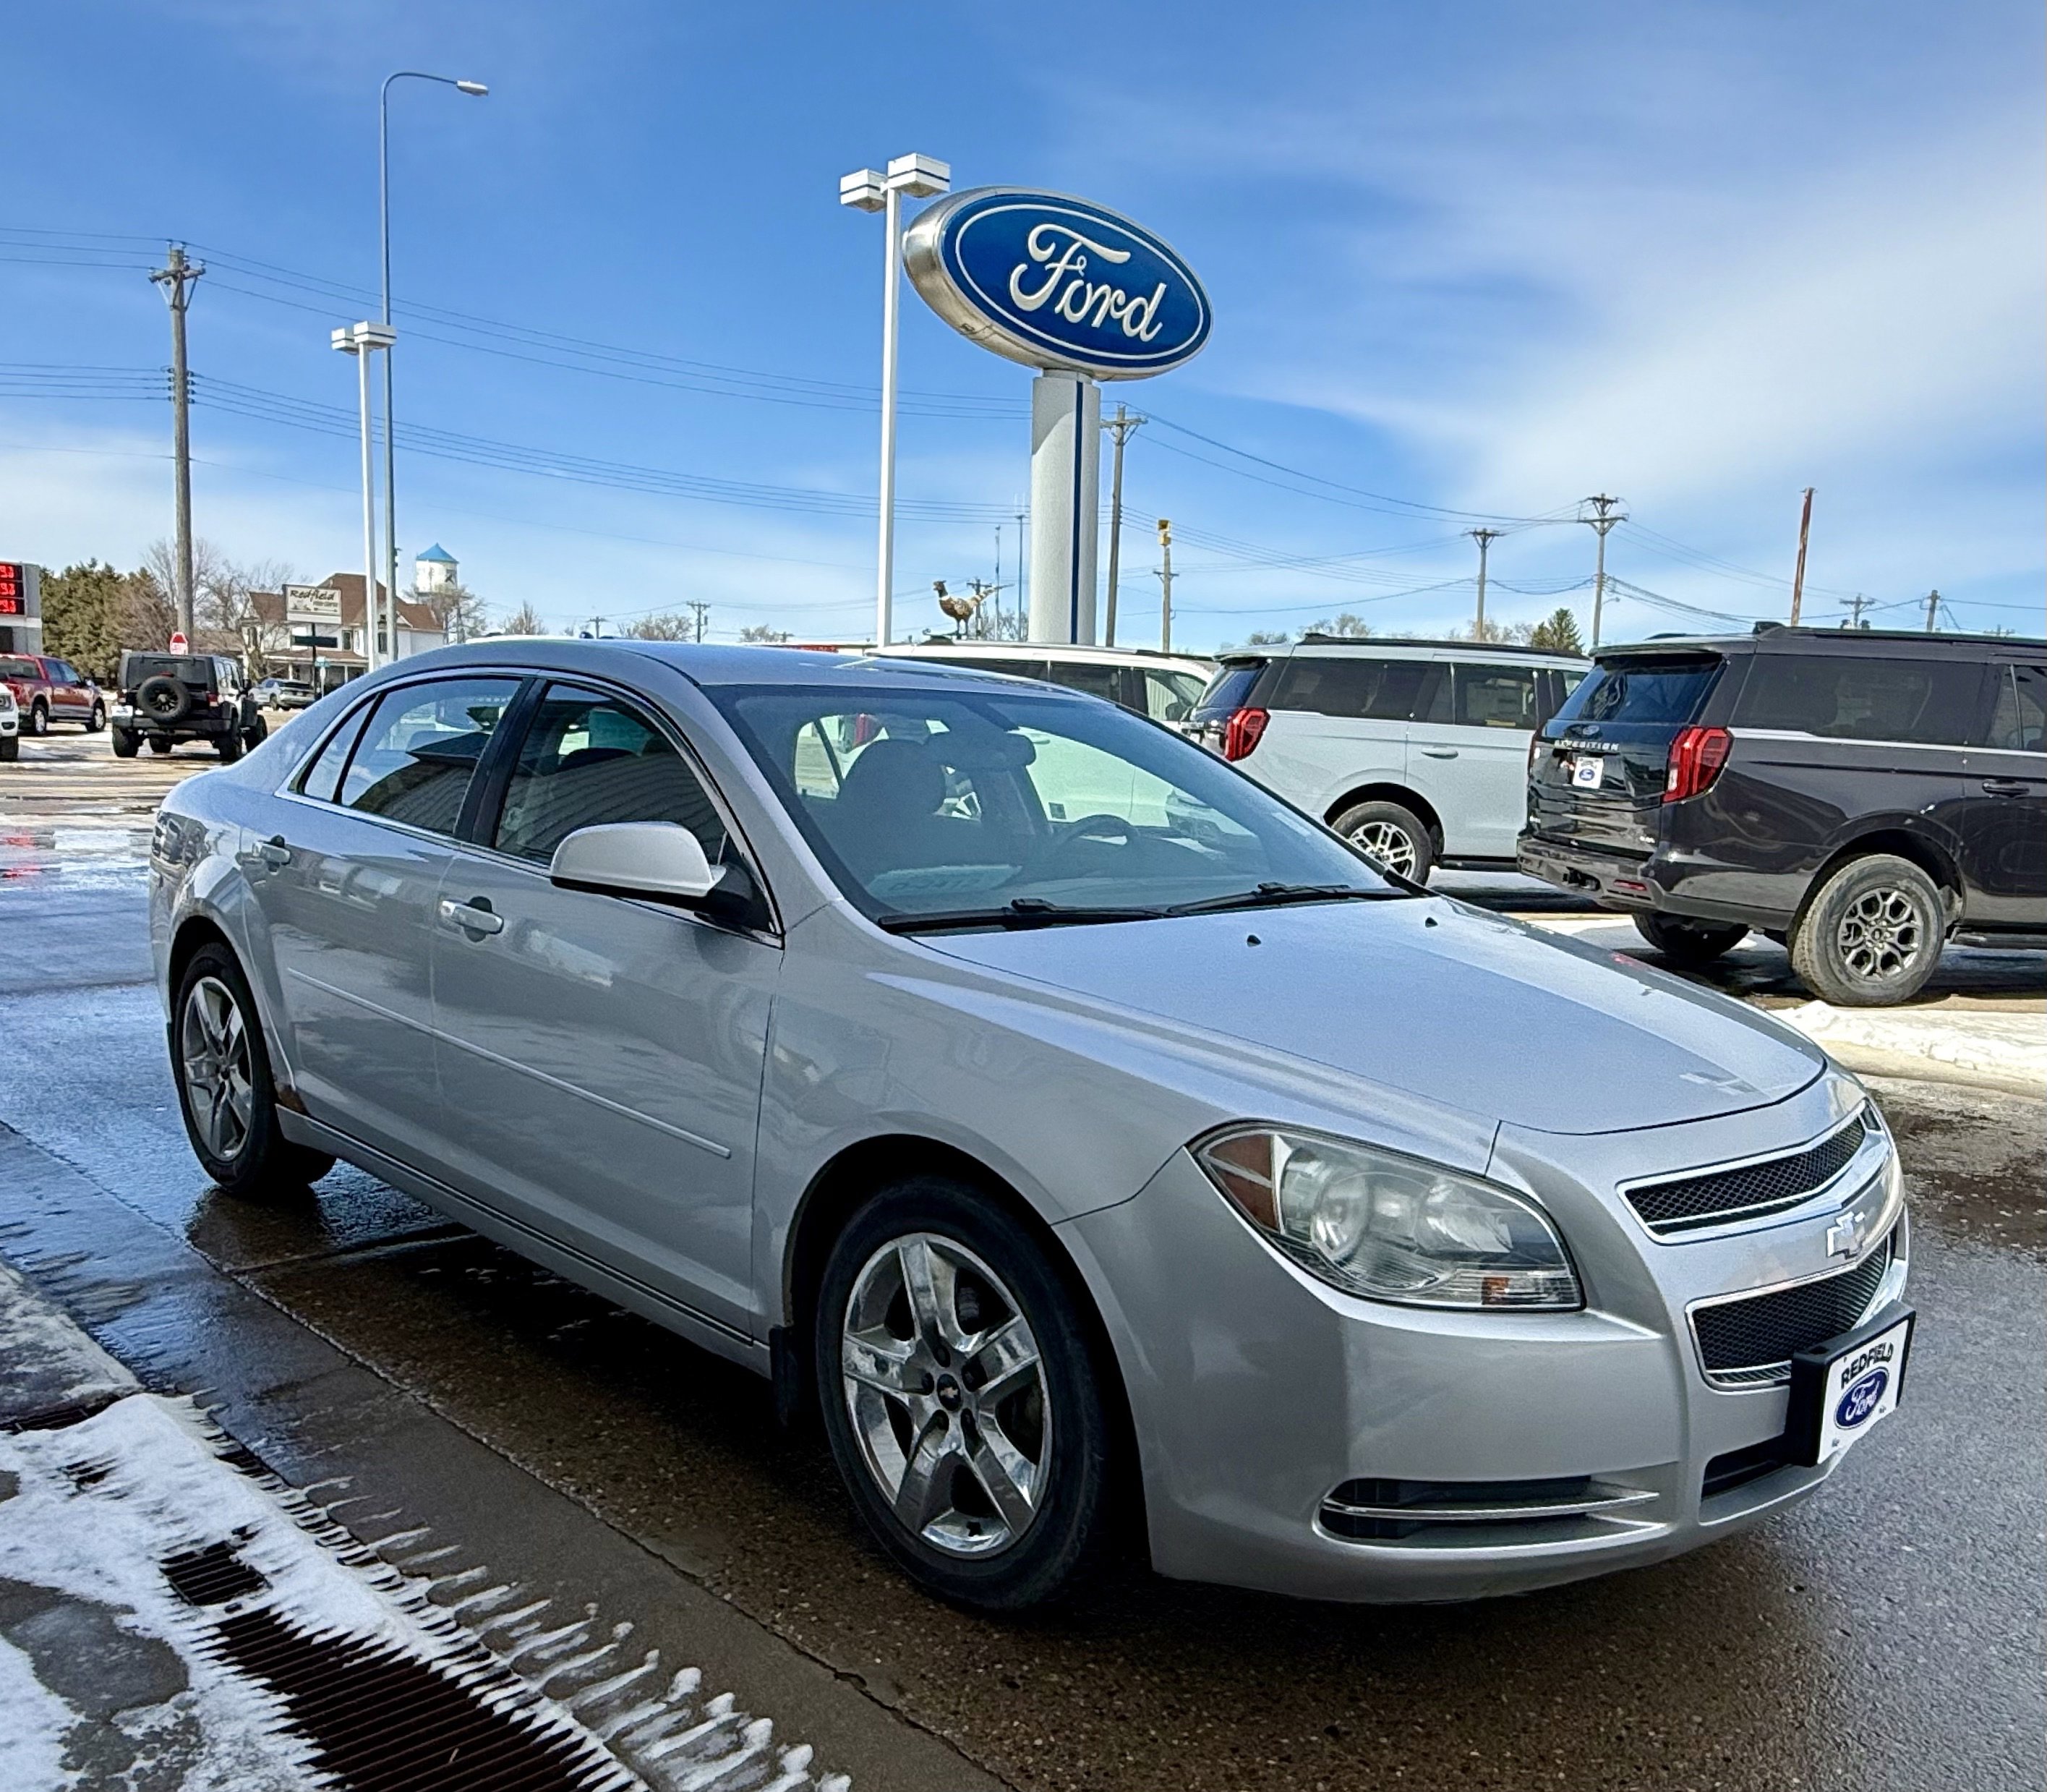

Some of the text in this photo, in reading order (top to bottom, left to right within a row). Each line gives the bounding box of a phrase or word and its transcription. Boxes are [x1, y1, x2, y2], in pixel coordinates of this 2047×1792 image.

[1009, 223, 1167, 343] Ford
[289, 589, 336, 602] Redfield
[1841, 1341, 1894, 1389] REDFIELD
[1845, 1377, 1881, 1422] Ford
